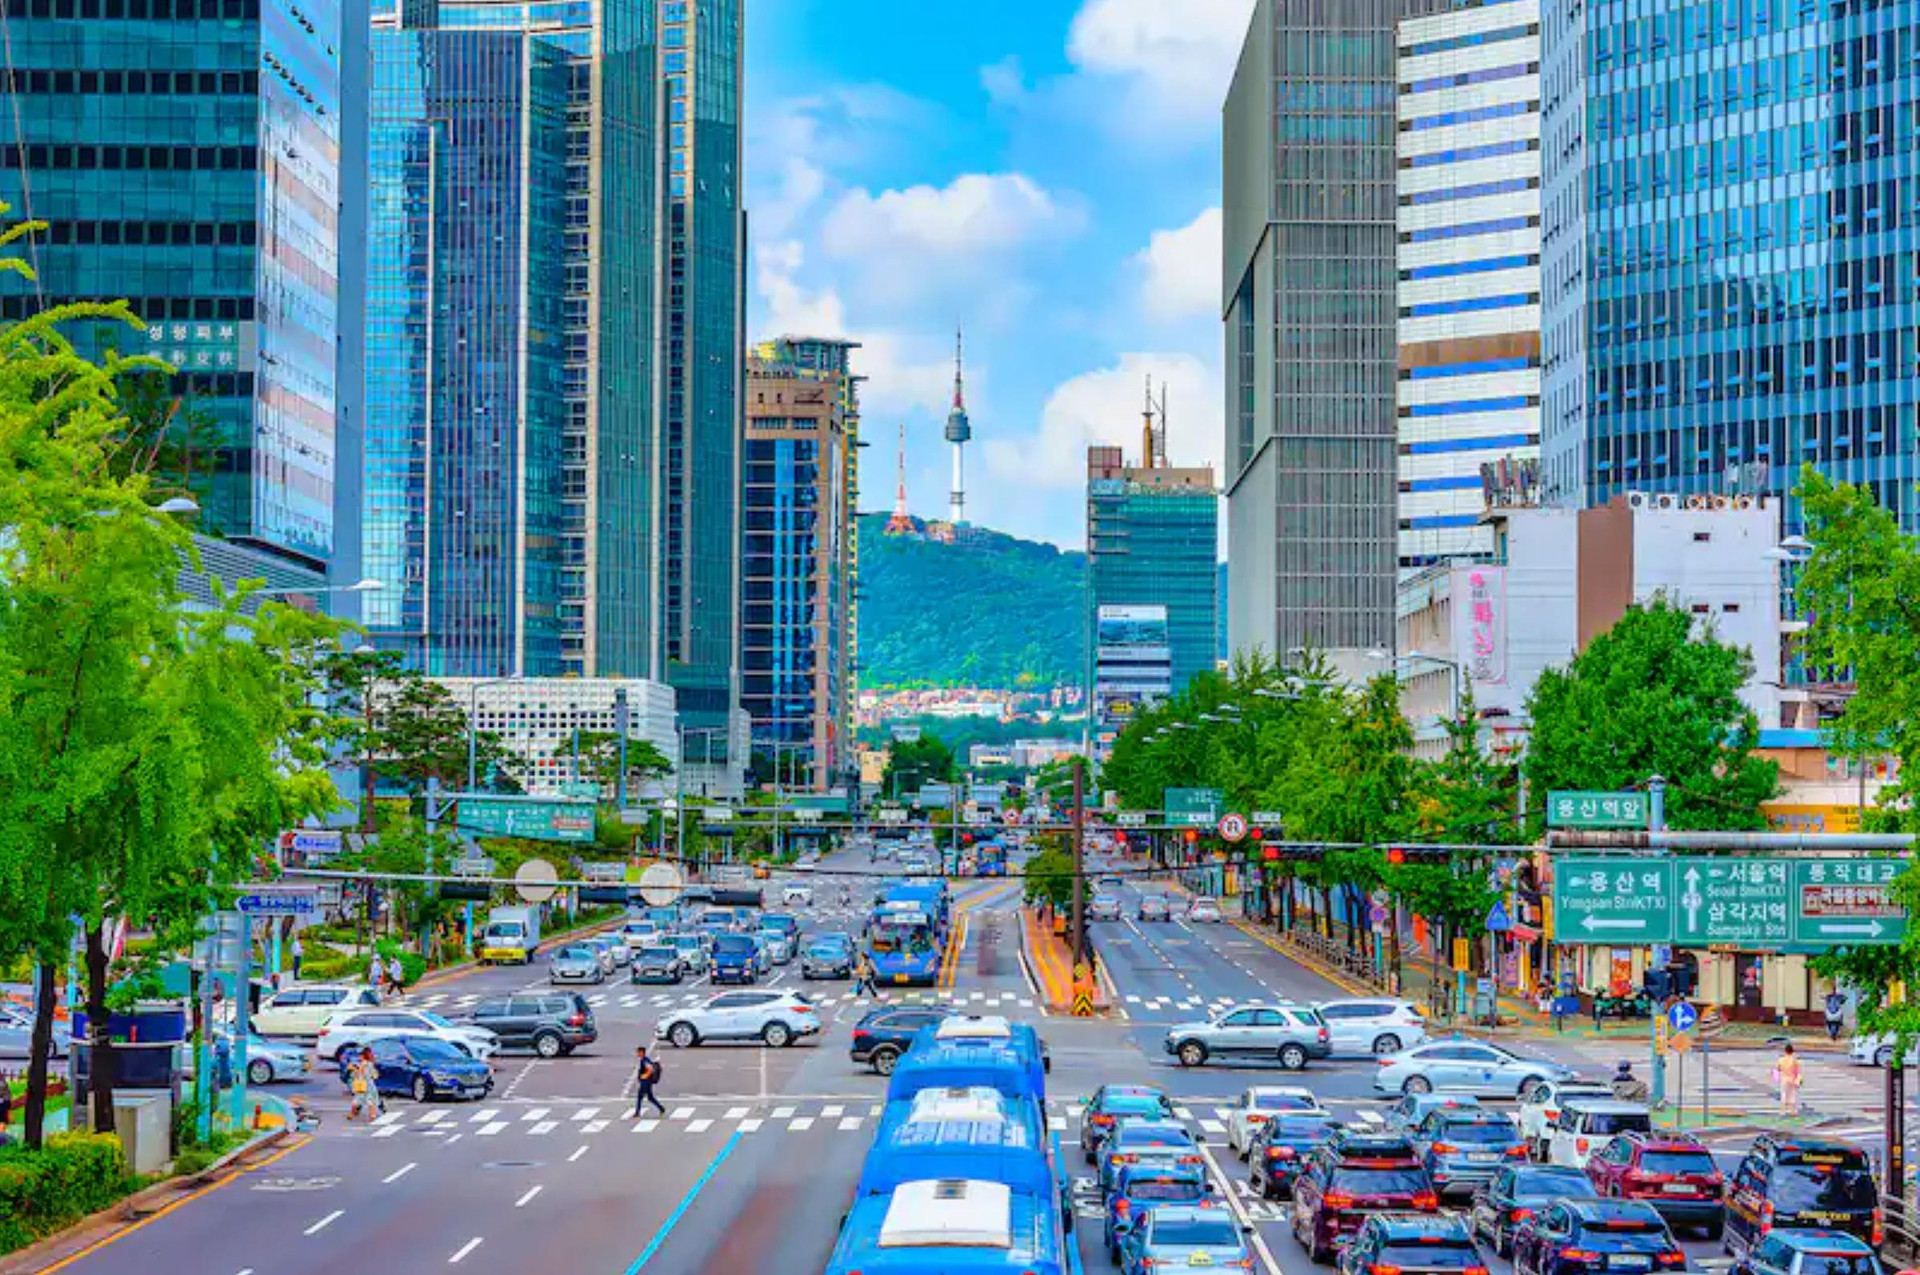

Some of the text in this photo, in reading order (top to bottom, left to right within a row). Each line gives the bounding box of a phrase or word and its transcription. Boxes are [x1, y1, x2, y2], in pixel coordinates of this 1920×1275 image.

[1558, 799, 1640, 819] 용산역앞
[1589, 871, 1661, 893] 용산역
[1728, 863, 1786, 883] 서울역
[1708, 901, 1786, 922] 삼각지역
